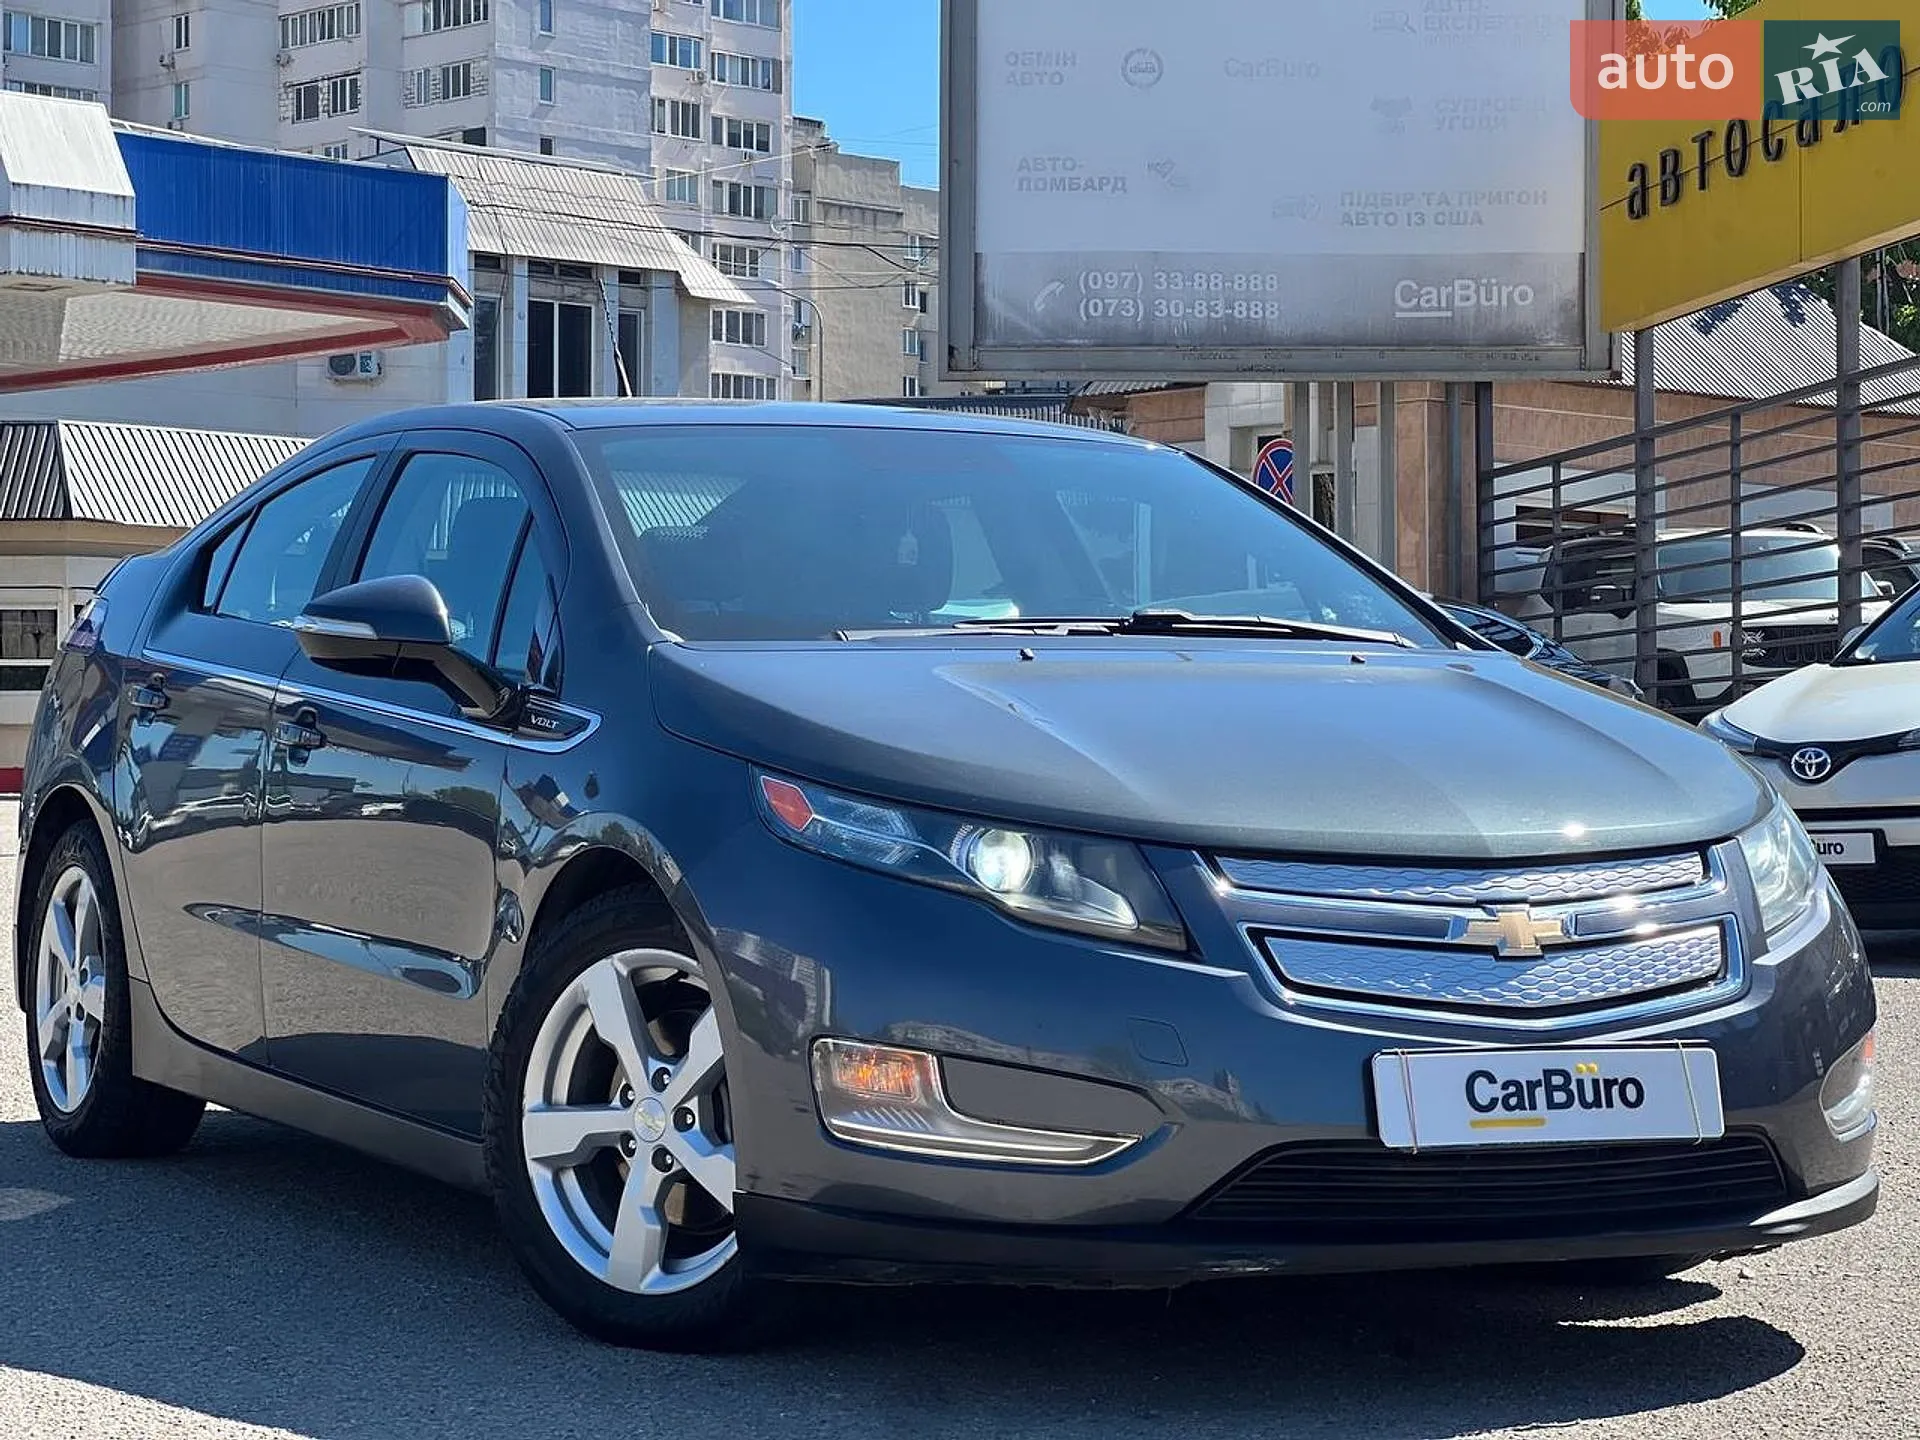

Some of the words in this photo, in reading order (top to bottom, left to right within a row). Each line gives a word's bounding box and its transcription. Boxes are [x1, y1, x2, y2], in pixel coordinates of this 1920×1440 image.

[1005, 51, 1077, 68] ОБМІН
[1006, 71, 1064, 86] АВТО
[1017, 157, 1083, 172] АВТО-
[1017, 176, 1127, 194] ПОМБАРД
[1340, 190, 1415, 207] ПІДБІР
[1422, 190, 1450, 206] ТА
[1457, 190, 1547, 206] ПРИГОН
[1341, 211, 1398, 227] АВТО
[1407, 212, 1427, 227] ІЗ
[1434, 211, 1485, 227] США
[1079, 271, 1143, 294] (097)
[1153, 272, 1278, 291] 33-88-888
[1395, 278, 1534, 309] CarBüro
[1080, 298, 1144, 321] (073)
[1153, 299, 1279, 318] 30-83-888
[530, 714, 559, 729] VOLT
[1465, 1062, 1645, 1113] CarBüro
